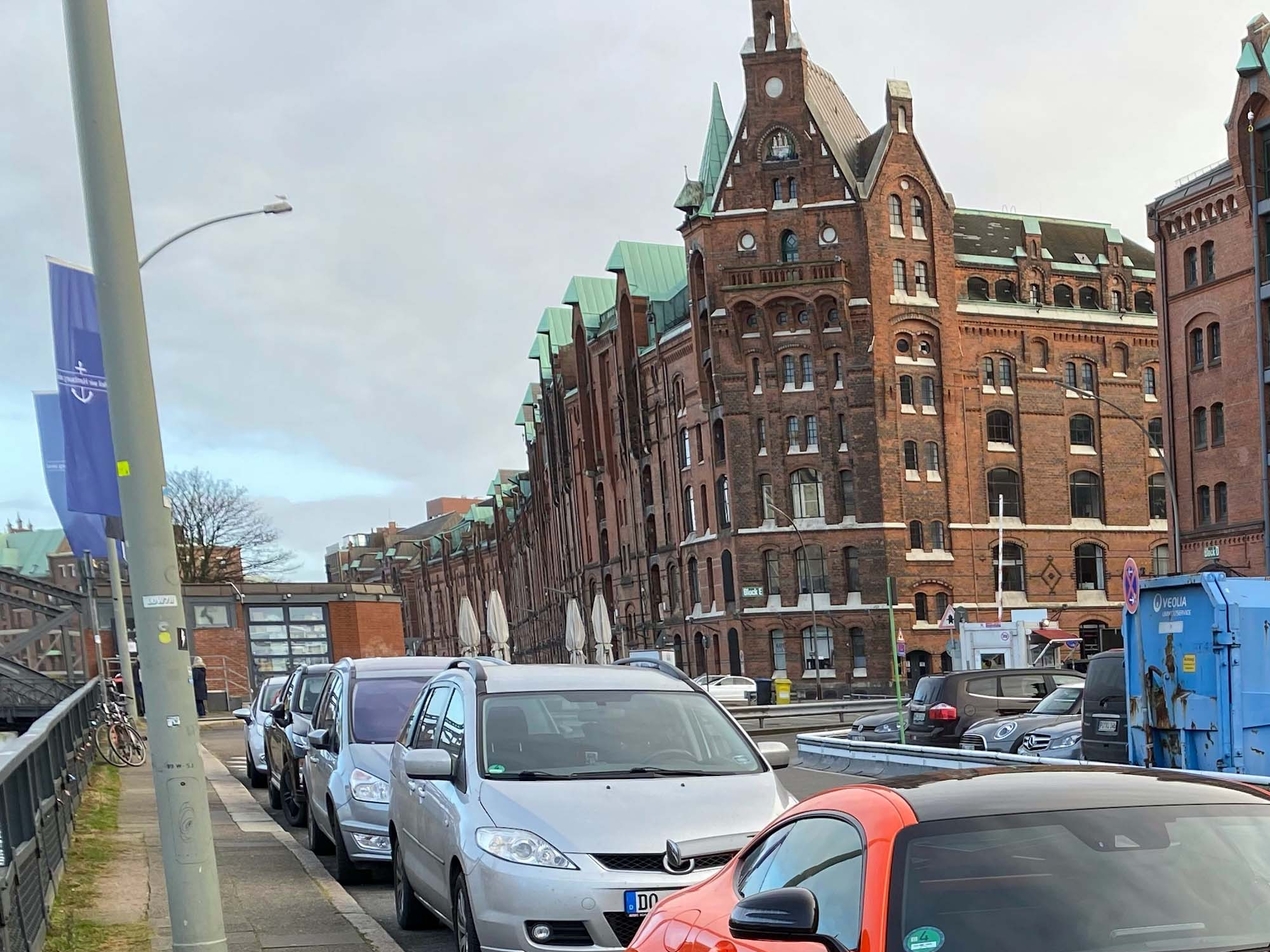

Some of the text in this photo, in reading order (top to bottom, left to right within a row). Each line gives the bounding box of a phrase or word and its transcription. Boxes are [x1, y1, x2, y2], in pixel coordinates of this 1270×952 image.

[1162, 596, 1187, 608] VEOLIA
[637, 893, 658, 911] DO
[919, 930, 929, 941] 4
